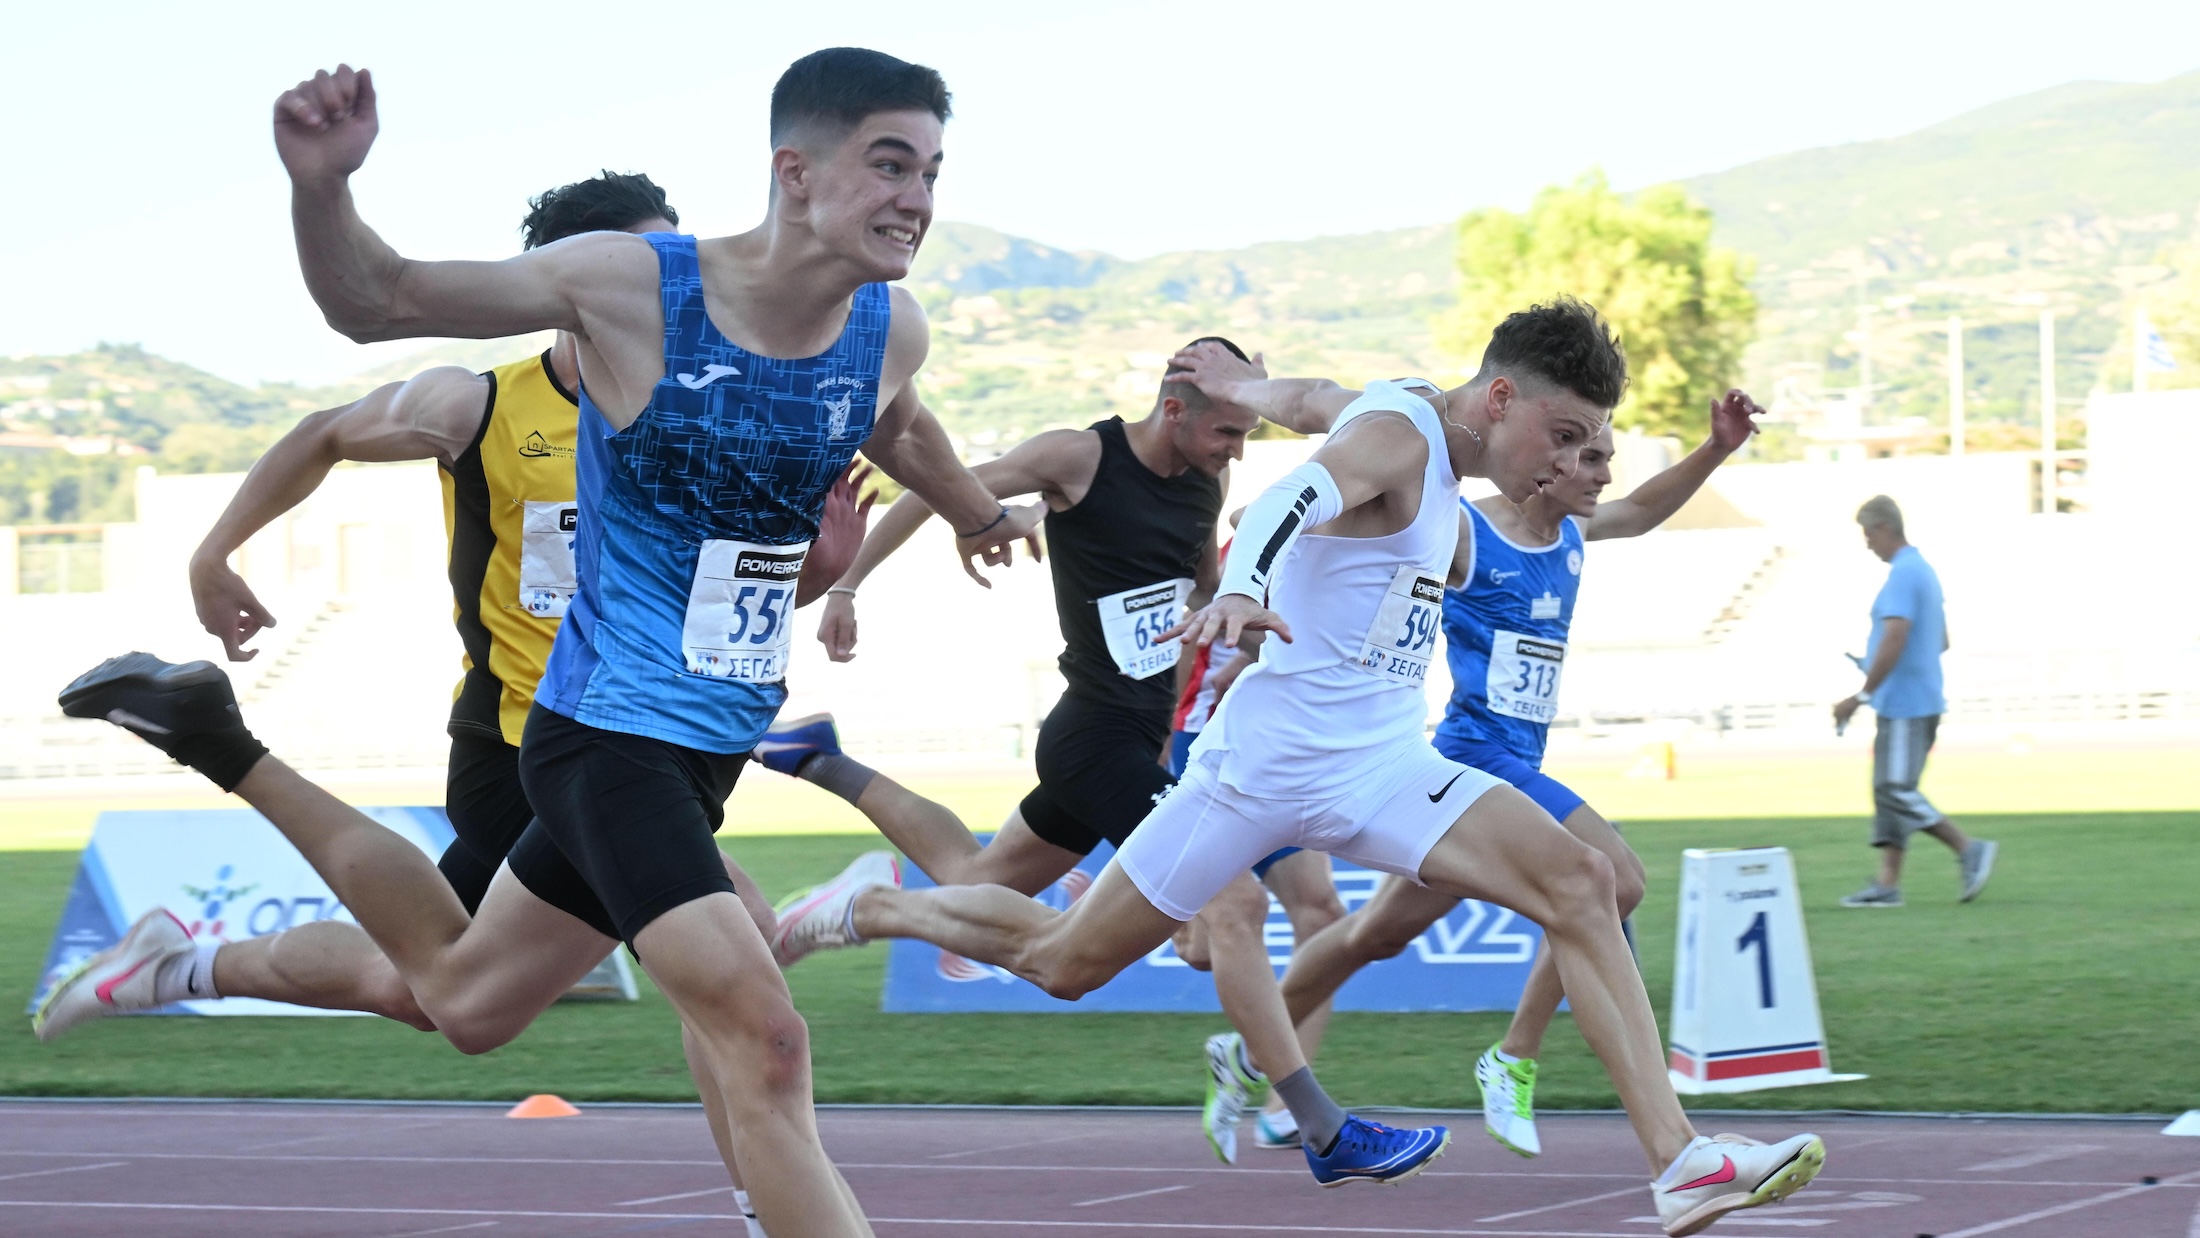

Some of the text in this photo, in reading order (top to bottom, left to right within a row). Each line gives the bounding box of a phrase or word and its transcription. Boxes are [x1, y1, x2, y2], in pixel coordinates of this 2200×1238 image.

[838, 376, 866, 390] ΒΟΛΟΥ
[1413, 582, 1444, 599] POWERAD
[1135, 607, 1174, 651] 656
[1396, 604, 1441, 655] 594
[726, 655, 778, 679] ΣΕΓΑΣ
[1140, 648, 1174, 672] ΣΕΓΑΣ
[1387, 656, 1428, 681] ΣΕΓΑΣ
[1513, 660, 1557, 699] 313
[1513, 700, 1546, 718] ΣΕΓΑΣ
[1736, 911, 1776, 1009] 1
